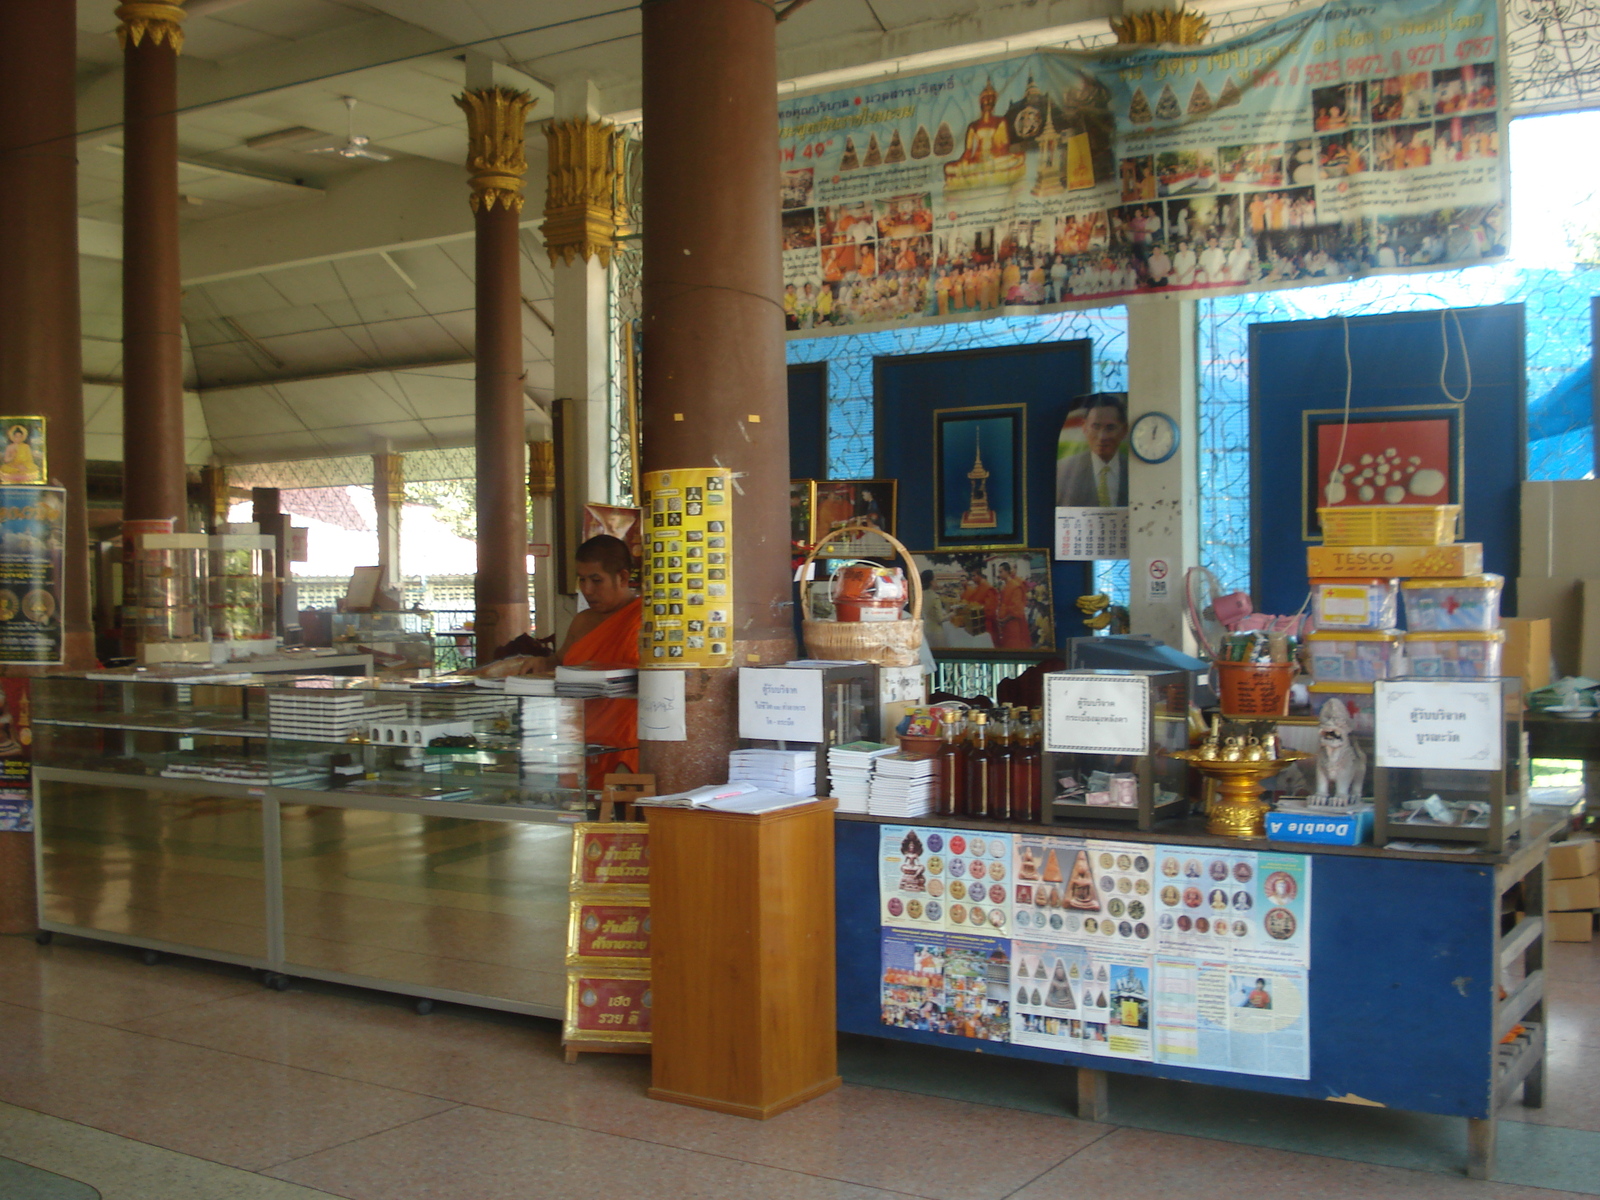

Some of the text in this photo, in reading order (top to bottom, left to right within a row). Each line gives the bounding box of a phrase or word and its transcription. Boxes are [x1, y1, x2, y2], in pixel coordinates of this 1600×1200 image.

[1392, 50, 1402, 71] 0
[1407, 43, 1446, 68] 9271
[1332, 552, 1394, 565] TESCO
[1270, 822, 1349, 836] Double A
[598, 1012, 624, 1025] รวย
